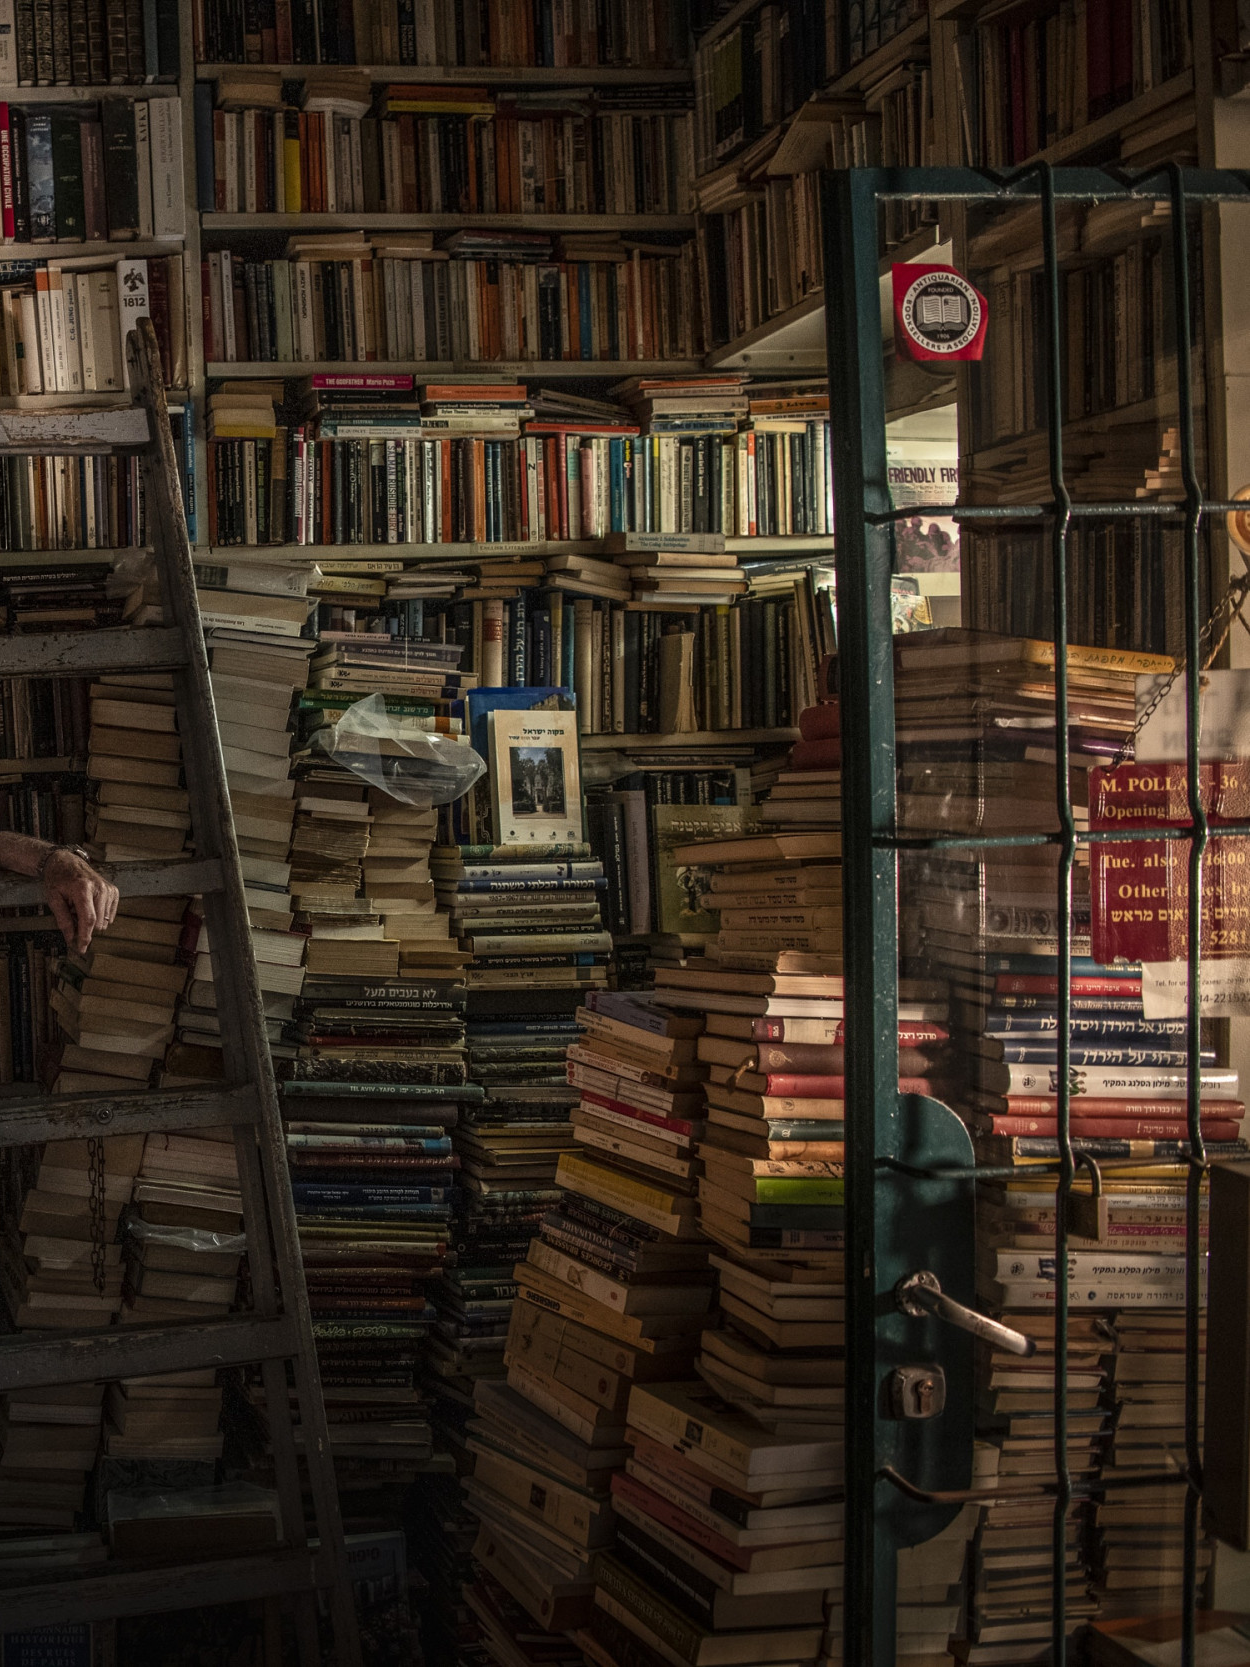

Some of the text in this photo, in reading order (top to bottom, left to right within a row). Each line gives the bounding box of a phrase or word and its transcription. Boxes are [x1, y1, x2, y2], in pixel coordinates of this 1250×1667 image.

[138, 107, 148, 142] KAFKA
[0, 129, 13, 209] UNE OCCUPATION CIVILE
[123, 297, 146, 308] 1812
[300, 290, 308, 319] KOSINSKI
[67, 306, 75, 325] JUNG
[904, 273, 980, 351] ANTIQUARIAN BOOKSELLERS ASSOCIATION
[325, 378, 395, 387] THE GODFATHER Mario Puzo
[888, 467, 959, 483] FRIENDLY FIR
[387, 445, 397, 532] SALMAN RUSHDIE FURY
[522, 727, 565, 736] מקוה ישראל
[1100, 774, 1238, 793] M. POLLA 36
[1104, 804, 1166, 820] Opening
[1103, 854, 1136, 868] Tue.
[1143, 853, 1179, 868] also
[490, 878, 596, 890] המזרח הבלתי משתנה
[1118, 881, 1249, 899] Other ties by
[1111, 909, 1154, 923] מראש
[1158, 908, 1210, 921] ביאום
[364, 986, 437, 999] לא בעבים מעל
[345, 1000, 377, 1008] בירושלים
[422, 1001, 453, 1009] אדריכלות
[1101, 1019, 1136, 1035] הירדן
[1138, 1018, 1155, 1034] אל
[1158, 1022, 1185, 1034] מסע
[1082, 1049, 1123, 1066] הירדן
[1128, 1045, 1147, 1065] על
[1102, 1079, 1127, 1088] המקיף
[1127, 1080, 1151, 1088] הסלנג
[560, 1220, 613, 1248] APOLLINAIRE
[545, 1232, 613, 1272] GEORGES BRASSENS
[1092, 1266, 1160, 1276] מילון הסלנג המקיף
[526, 1289, 560, 1311] GINSBERG
[1106, 1292, 1143, 1300] שטראסה
[1146, 1291, 1173, 1300] יהודה
[10, 1634, 85, 1644] HISTORIQUE
[21, 1647, 76, 1657] DES RUES
[39, 1658, 76, 1667] PARIS
